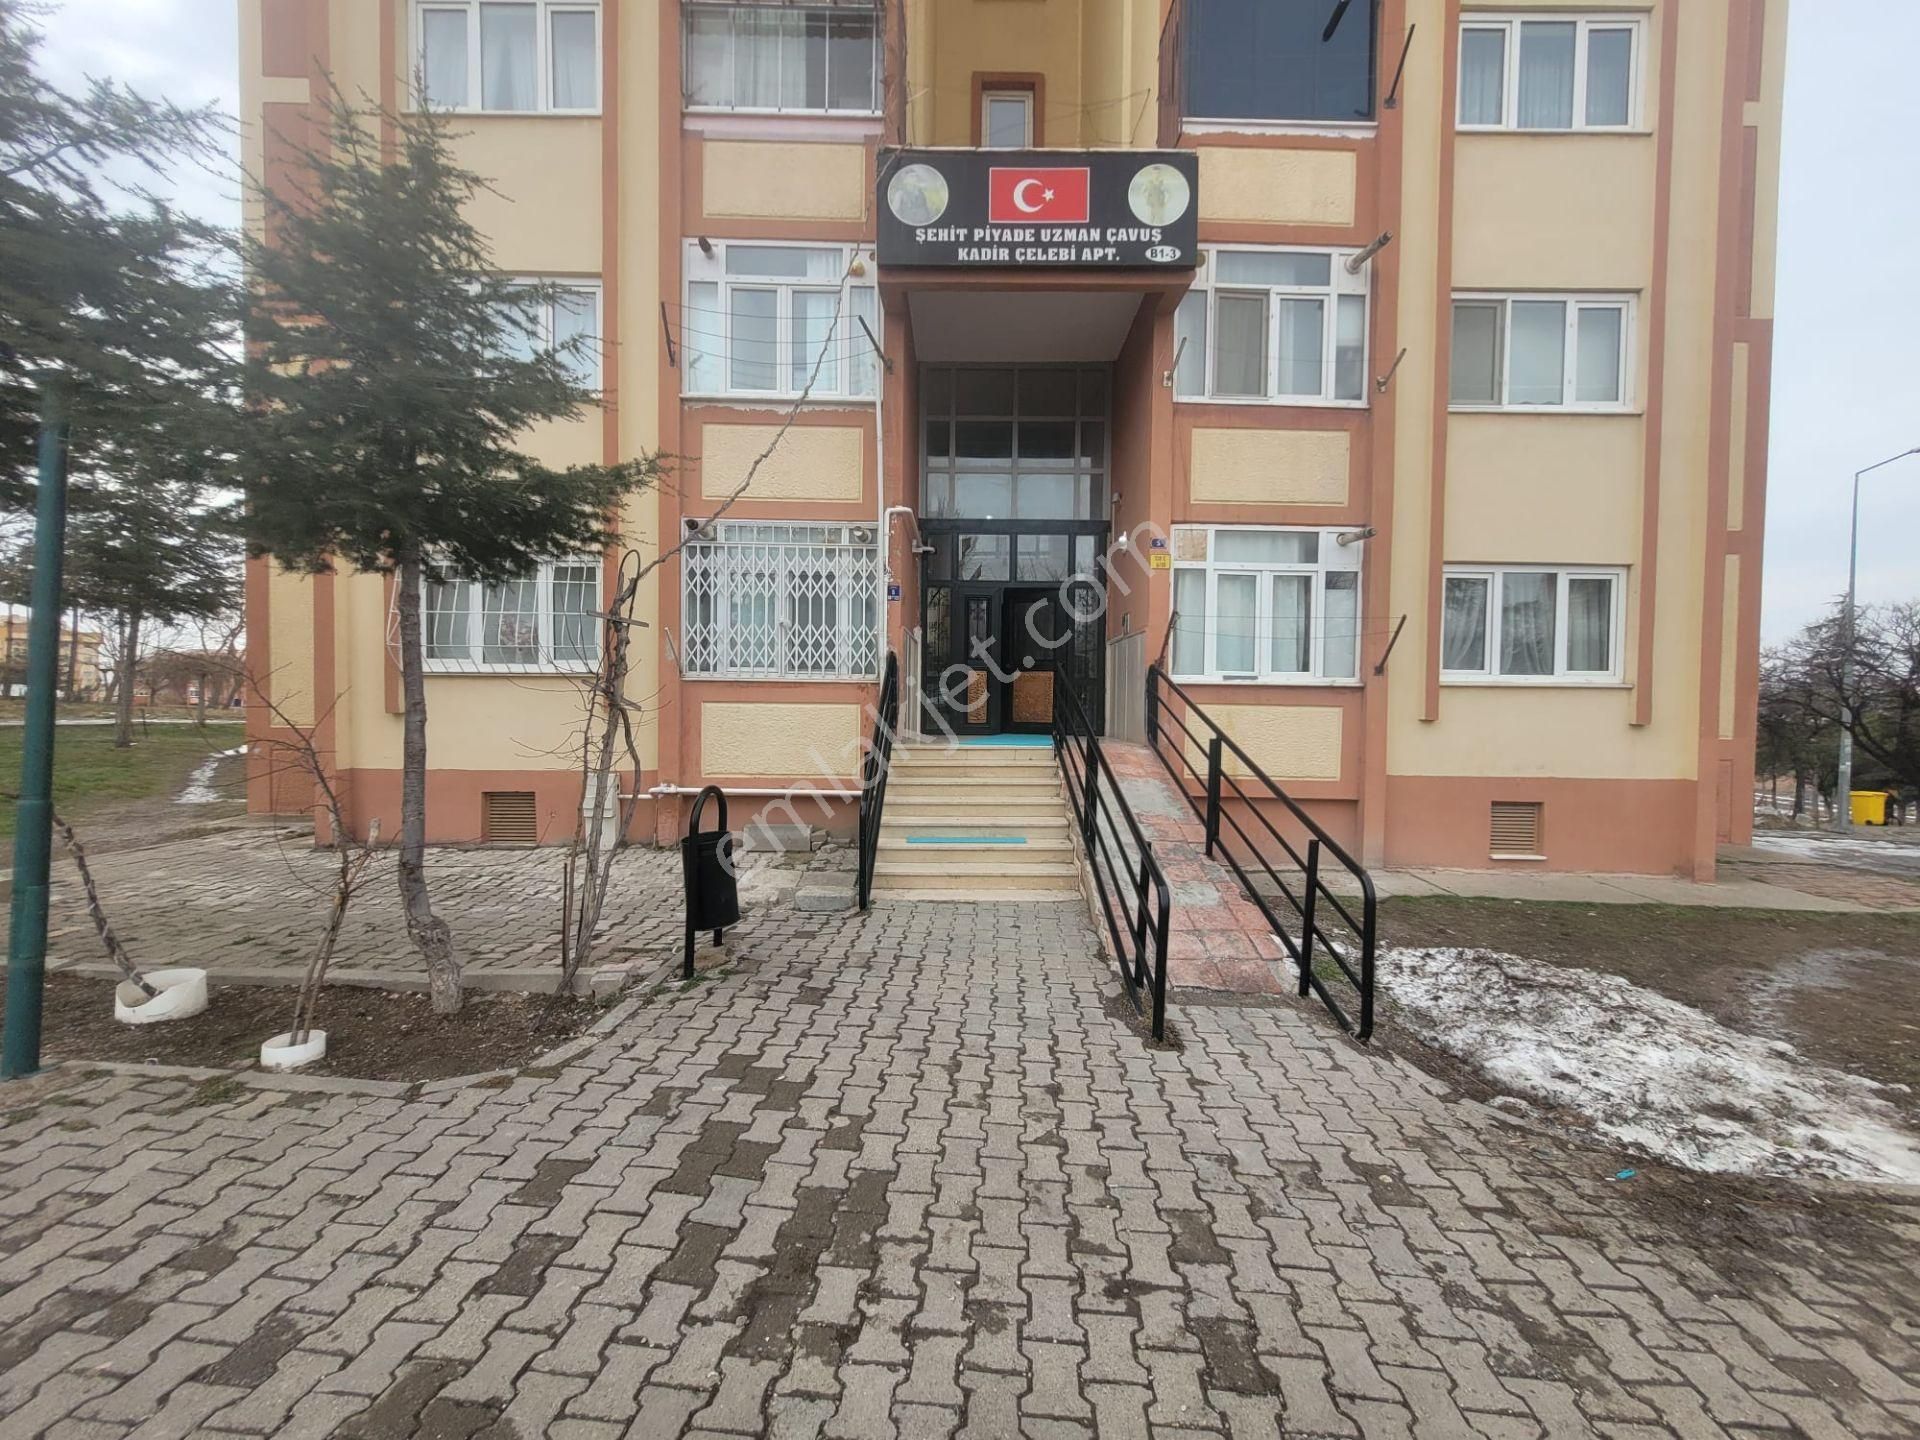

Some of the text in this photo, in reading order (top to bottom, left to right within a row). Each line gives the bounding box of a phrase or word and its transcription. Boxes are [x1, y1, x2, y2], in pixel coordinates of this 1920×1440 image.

[915, 224, 1162, 245] ŞEHİT PİYADE UZMAN ÇAVUŞ
[958, 244, 1119, 264] KADİR ÇELEBİ APT.
[1150, 247, 1177, 260] B1-3
